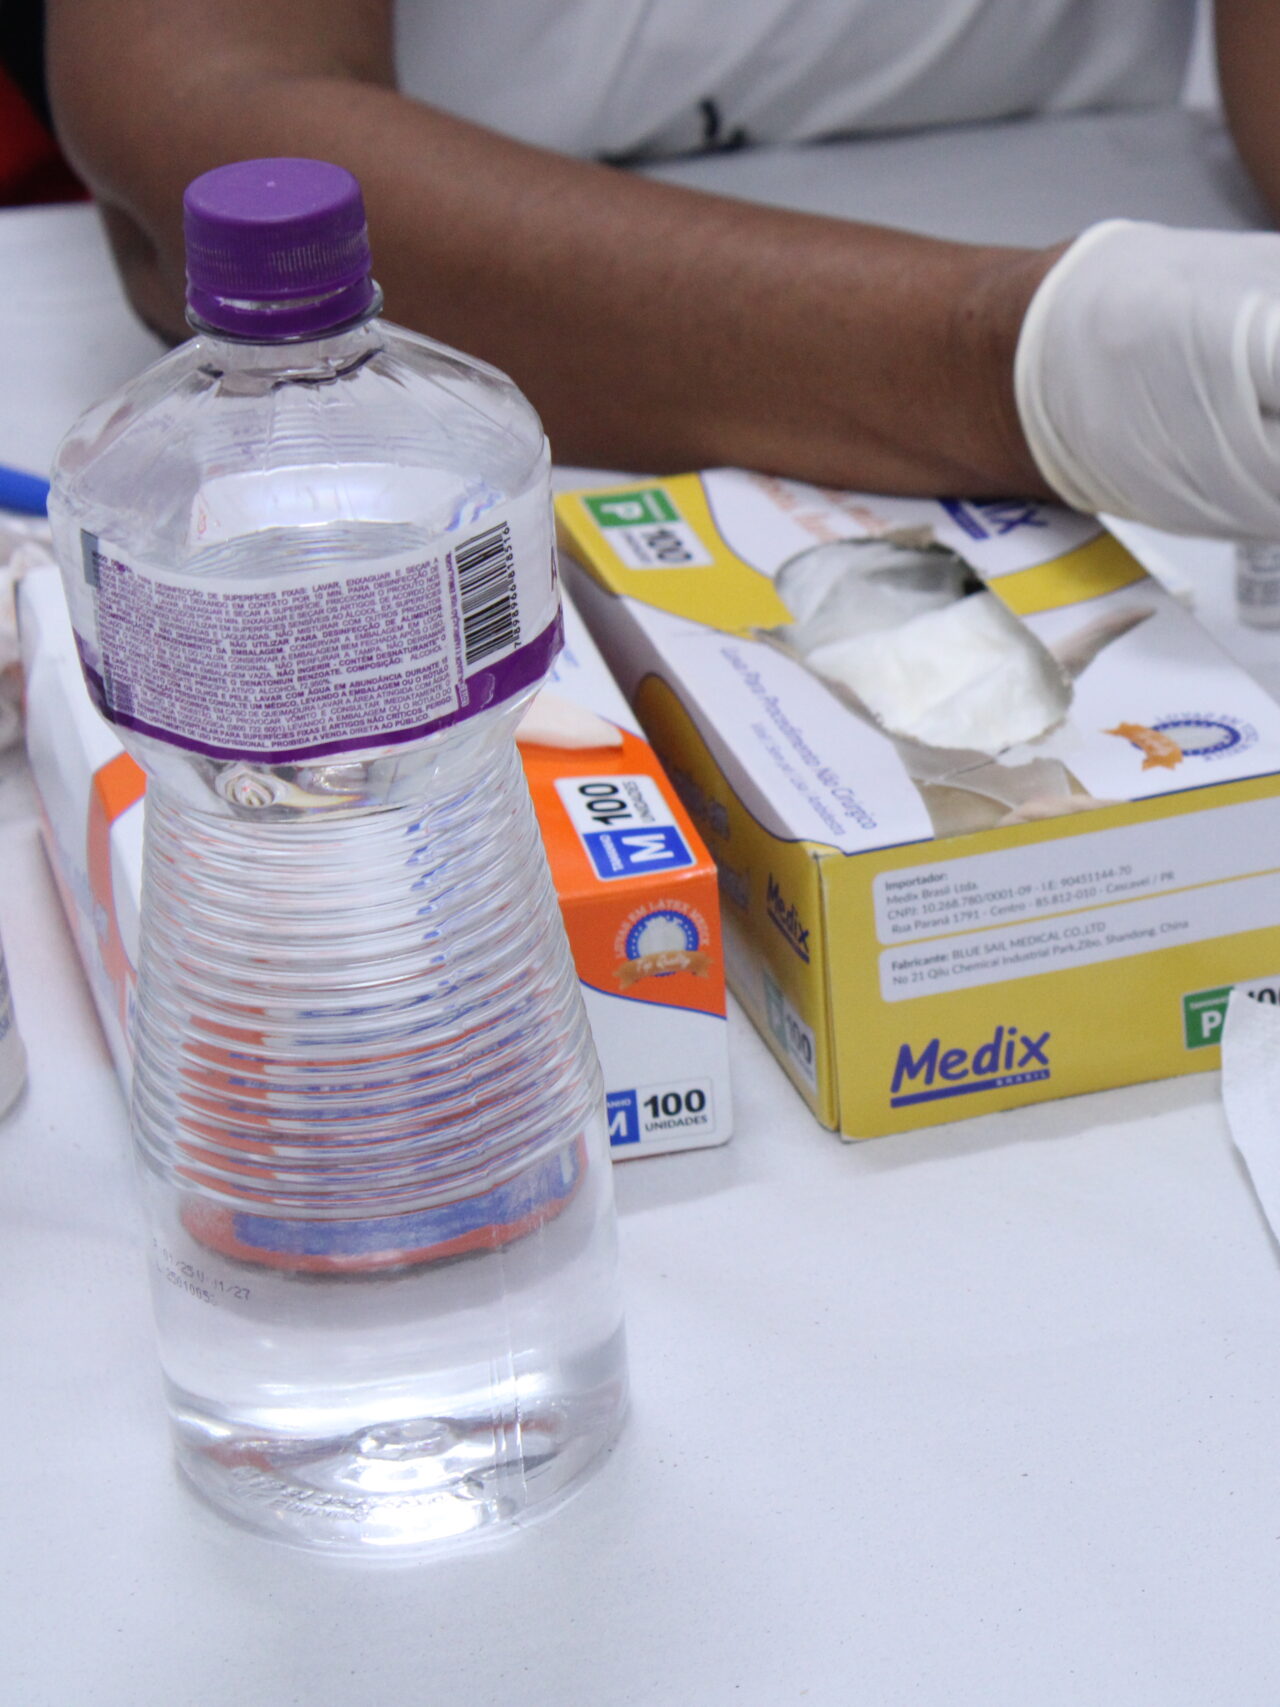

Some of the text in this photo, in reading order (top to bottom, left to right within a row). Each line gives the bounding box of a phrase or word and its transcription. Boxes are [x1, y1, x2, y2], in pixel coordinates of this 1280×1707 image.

[222, 560, 431, 601] SUPERFÍCIES ENXAGUAR SECAR
[248, 598, 288, 609] CONTATO
[291, 595, 310, 604] POR
[347, 584, 370, 594] PARA
[373, 570, 428, 590] DESINFECÇÃO
[325, 591, 375, 606] FRICCIONAR
[386, 579, 425, 594] PRODUTO
[426, 573, 440, 584] NOS
[232, 623, 286, 632] SUPERFÍCIES
[332, 613, 344, 621] AO
[395, 589, 442, 609] SUPERFÍCIES
[242, 615, 287, 625] ENXAGUAR
[296, 608, 324, 619] SECAR
[426, 581, 441, 592] COM
[275, 597, 441, 638] NÃO MISTURAR COM OUTROS PRODUTOS
[229, 605, 442, 648] NÃO UTILIZAR PARA DESINFECÇÃO ALIMENTOS
[288, 645, 338, 660] EMBALAGEM
[340, 642, 358, 651] BEM
[360, 634, 398, 648] FECHADA
[400, 627, 421, 639] APÓS
[290, 613, 442, 652] CONSERVAR EMBALAGEM EM LOCAL
[274, 660, 294, 670] NÃO
[296, 652, 340, 666] PERFURAR
[386, 639, 404, 651] NÃO
[276, 654, 374, 677] NÃO INGERIR CONTÉM
[254, 661, 441, 702] LAVAR COM ÁGUA EM ABUNDÂNCIA DURANTE
[258, 684, 296, 695] ALCOHOL
[260, 673, 450, 718] QUEIMADURA LAVAR ÁREA ATINGIDA COM ÁGUA
[300, 691, 340, 705] LEVANDO
[349, 681, 401, 697] EMBALAGEM
[401, 678, 414, 686] OU
[422, 666, 448, 680] RÓTULO
[236, 685, 443, 725] PROVOCAR VÔMITO CONSULTAR IMEDIATAMENTE
[287, 693, 441, 731] LEVANDO EMBALAGEM OU RÓTULO
[242, 731, 295, 740] SUPERFÍCIES
[296, 727, 320, 737] FIXAS
[328, 719, 366, 730] ARTIGOS
[367, 714, 385, 725] NÃO
[271, 737, 310, 748] PROIBIDA
[319, 729, 348, 740] VENDA
[350, 724, 380, 735] DIRETA
[381, 721, 394, 730] AO
[578, 783, 633, 826] 100
[621, 832, 676, 865] M
[885, 872, 949, 892] Importador:
[887, 893, 919, 905] Medix
[921, 885, 951, 900] Brasil
[891, 923, 913, 934] Rua
[953, 910, 980, 923] 1791
[989, 902, 1027, 917] Centro
[1160, 870, 1176, 882] PR
[891, 953, 949, 972] Fabricante:
[952, 945, 980, 960] BLUE
[983, 940, 1006, 954] SAIL
[1009, 931, 1060, 949] MEDICAL
[911, 971, 925, 983] 21
[951, 955, 1000, 974] Chemical
[1002, 946, 1050, 966] Industrial
[1159, 920, 1190, 935] China
[1201, 1010, 1223, 1039] P
[890, 1025, 1051, 1093] Medix
[643, 1089, 706, 1119] 100
[644, 1114, 708, 1132] UNIDADES
